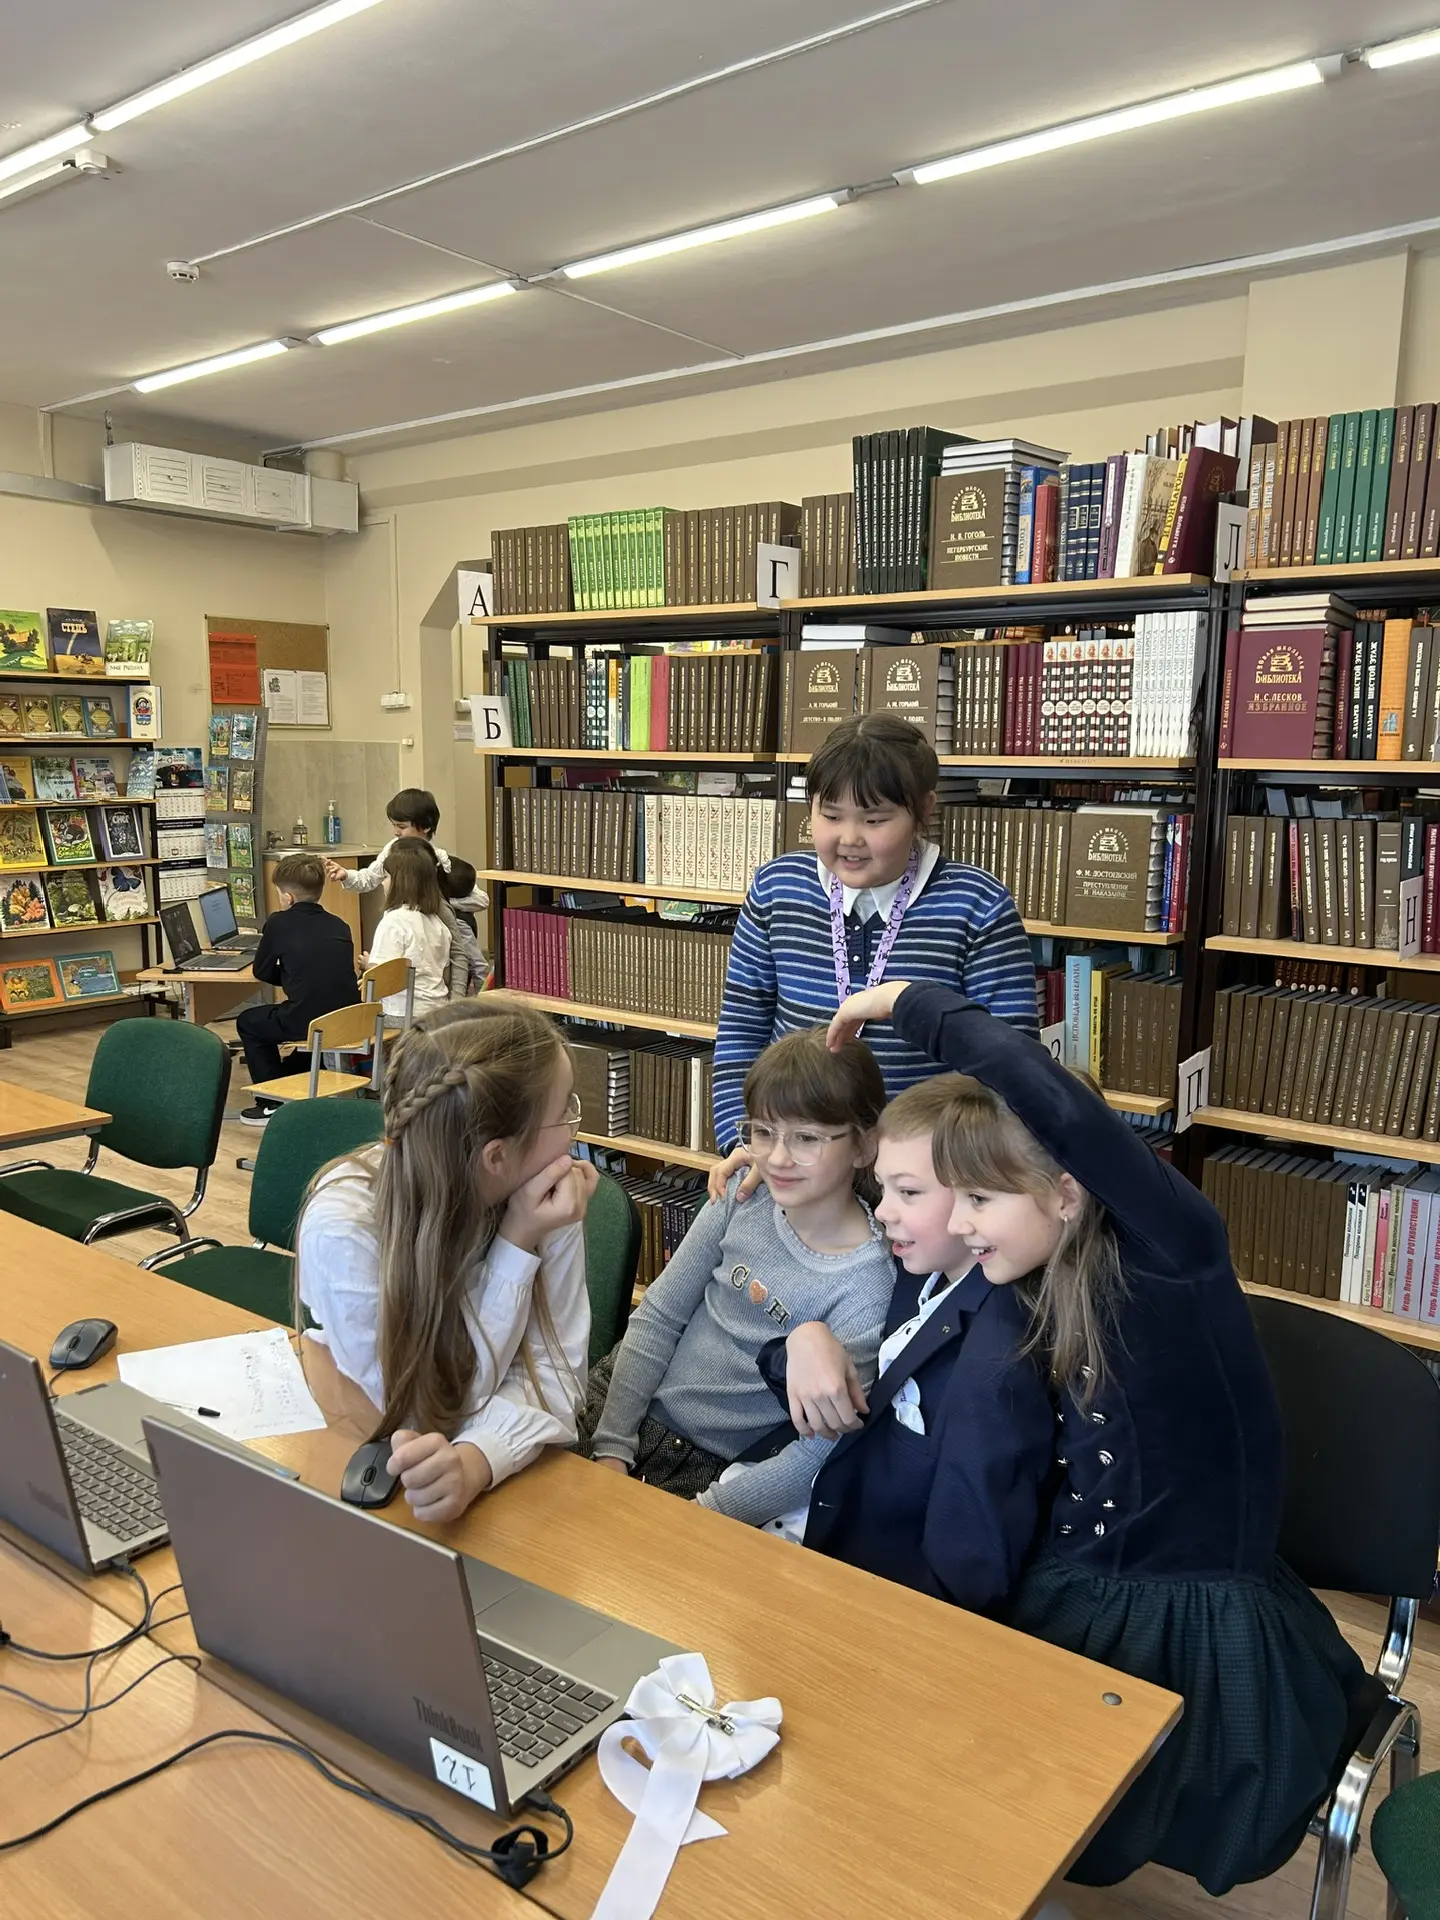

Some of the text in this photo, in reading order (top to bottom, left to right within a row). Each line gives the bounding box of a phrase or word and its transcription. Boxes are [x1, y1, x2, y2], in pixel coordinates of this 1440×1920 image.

[965, 531, 985, 539] ГОГОЛЬ
[1223, 523, 1242, 570] Л
[947, 544, 988, 553] ПЕТЕРБУРГСКИЕ
[955, 553, 979, 561] ПОВЕСТИ
[768, 559, 789, 598] Г
[467, 584, 490, 616] А
[61, 622, 87, 633] СТЕПЬ
[1355, 642, 1363, 664] ЭТАЖ
[1255, 671, 1301, 683] БИБЛИОТЕКА
[1353, 665, 1361, 699] ШЕСТОЙ
[1248, 703, 1307, 711] ИЗБРАННОЕ
[482, 707, 502, 740] Б
[1093, 870, 1137, 879] ДОСТОЕВСКИЙ
[1404, 895, 1418, 946] Н
[1072, 1003, 1080, 1042] ИСПОВЕДЬ
[1184, 1067, 1205, 1118] П
[1344, 1233, 1353, 1257] Похороны
[1354, 1235, 1363, 1259] Похороны
[1402, 1199, 1419, 1312] Игорь Потёмкин ПРОТИВОСТОЯНИЕ
[1388, 1252, 1397, 1276] Повесть
[1428, 1296, 1437, 1318] Игорь
[412, 1695, 484, 1753] ThinkBook
